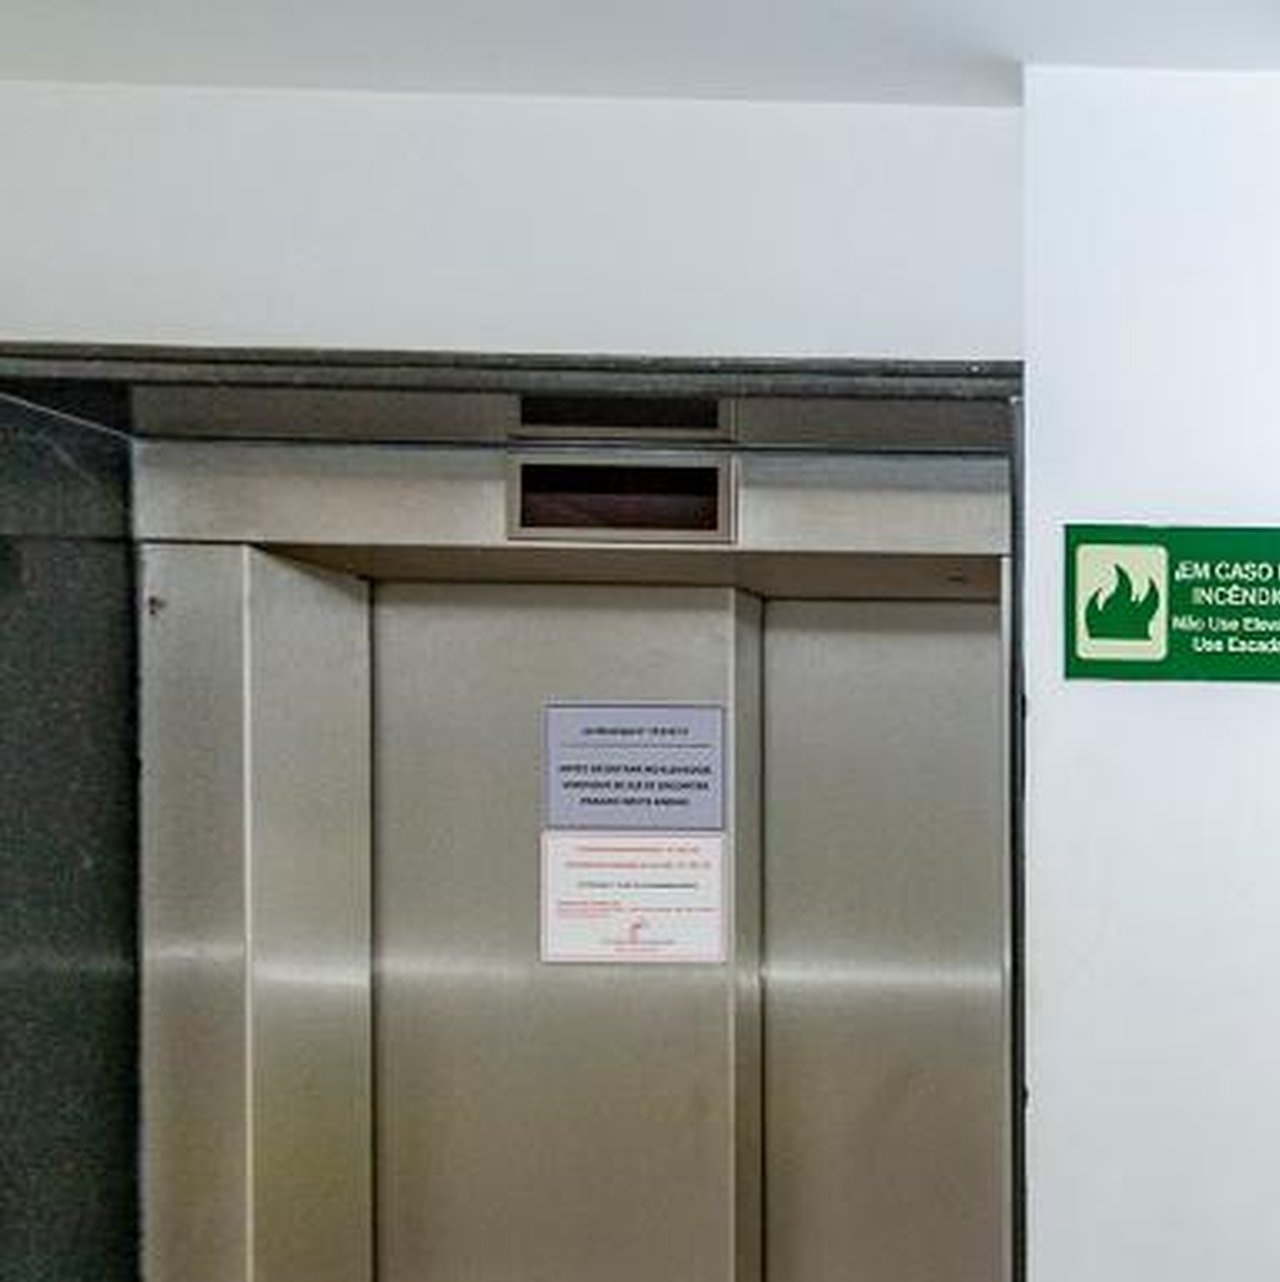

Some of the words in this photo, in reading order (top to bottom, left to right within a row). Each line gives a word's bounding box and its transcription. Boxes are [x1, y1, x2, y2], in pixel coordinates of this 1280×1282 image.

[1214, 561, 1274, 581] CASO
[1171, 614, 1206, 631] Não
[1208, 616, 1240, 632] Use
[1191, 637, 1223, 653] Use
